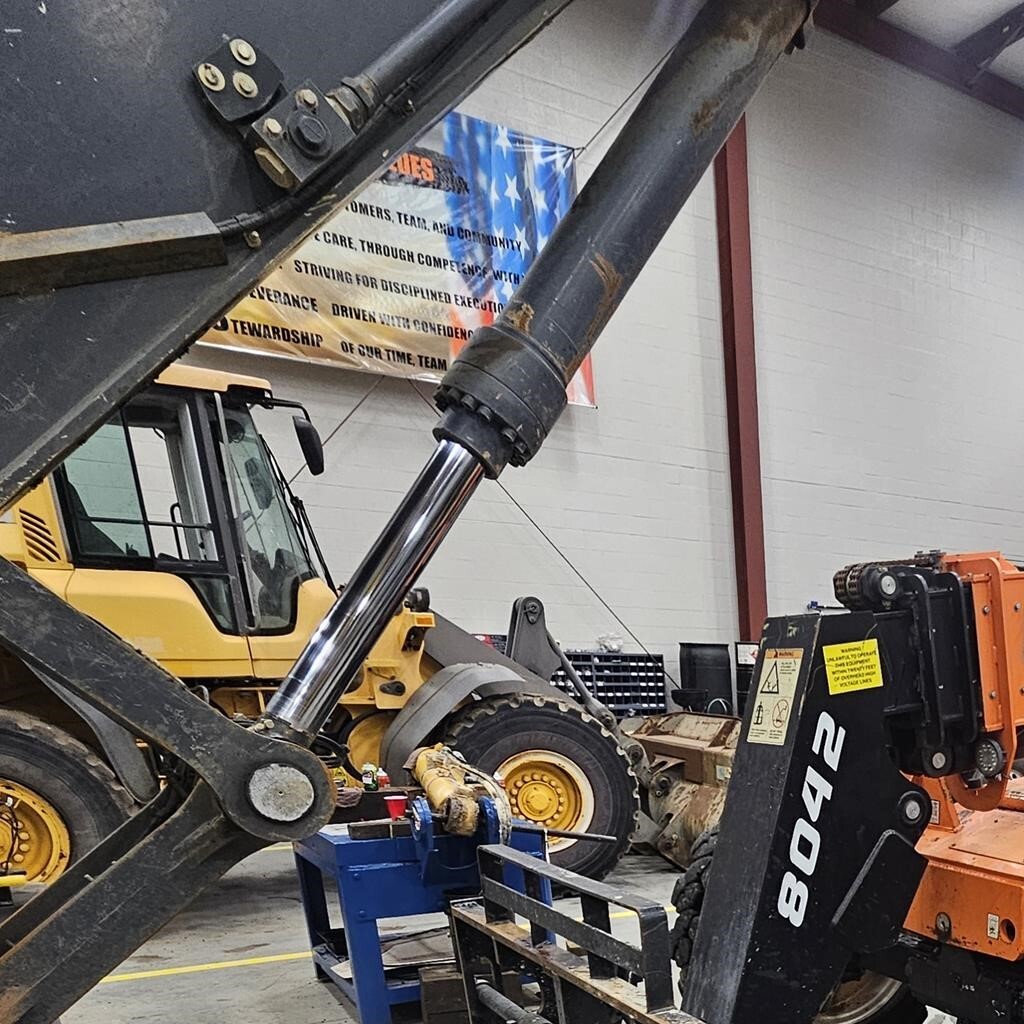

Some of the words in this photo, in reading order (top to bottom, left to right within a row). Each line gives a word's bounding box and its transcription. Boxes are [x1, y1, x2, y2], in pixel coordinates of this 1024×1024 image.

[359, 239, 415, 263] THROUGH
[433, 221, 453, 236] AND
[457, 228, 522, 252] COMMUNITY
[294, 260, 352, 284] STRIVING
[355, 274, 378, 289] FOR
[380, 279, 452, 304] DISCIPLINED
[454, 294, 505, 314] EXECUTIO
[331, 303, 376, 323] DRIVEN
[380, 312, 410, 330] WITH
[340, 340, 354, 354] OF
[358, 344, 382, 360] OUR
[417, 354, 447, 371] TEAM
[777, 711, 846, 928] 8042
